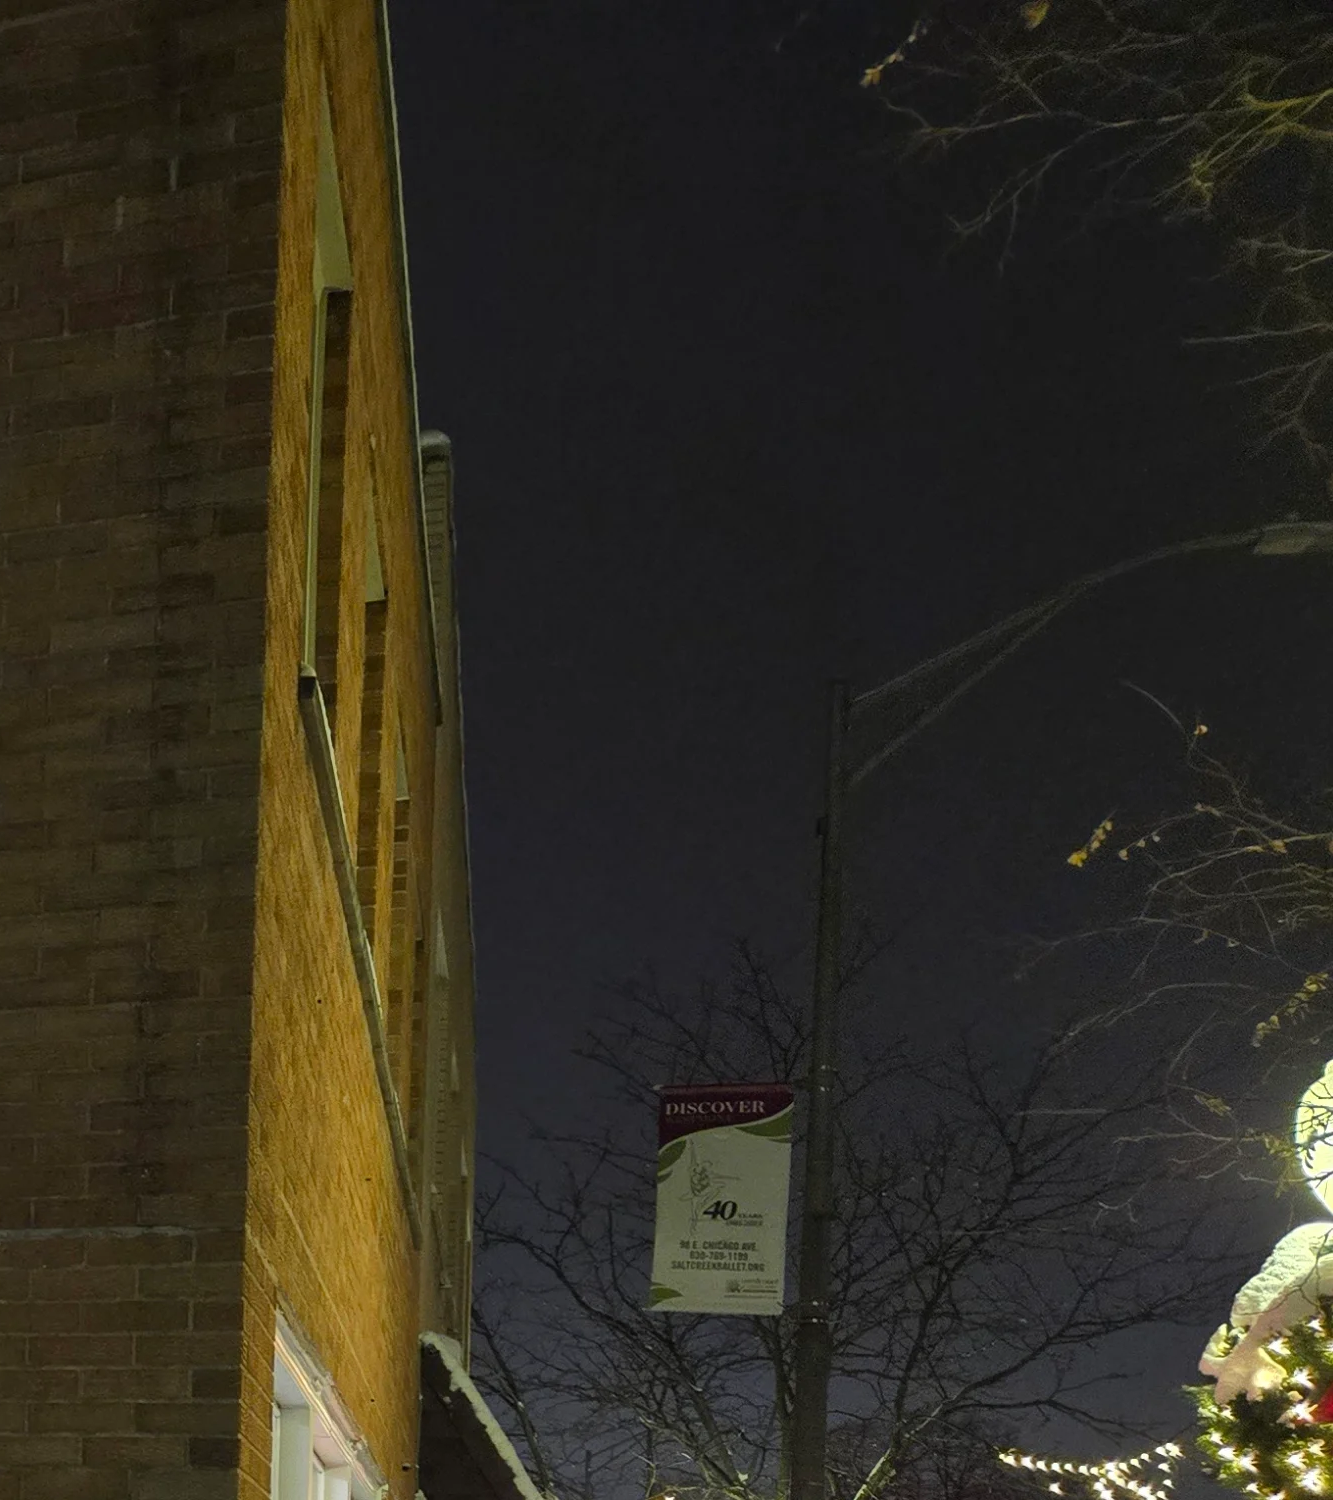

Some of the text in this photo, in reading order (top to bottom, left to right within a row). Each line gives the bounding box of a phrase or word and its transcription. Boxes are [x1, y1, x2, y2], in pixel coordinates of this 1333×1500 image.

[665, 1100, 765, 1116] DISCOVER
[703, 1200, 738, 1220] 40
[702, 1240, 739, 1250] CHICAGO
